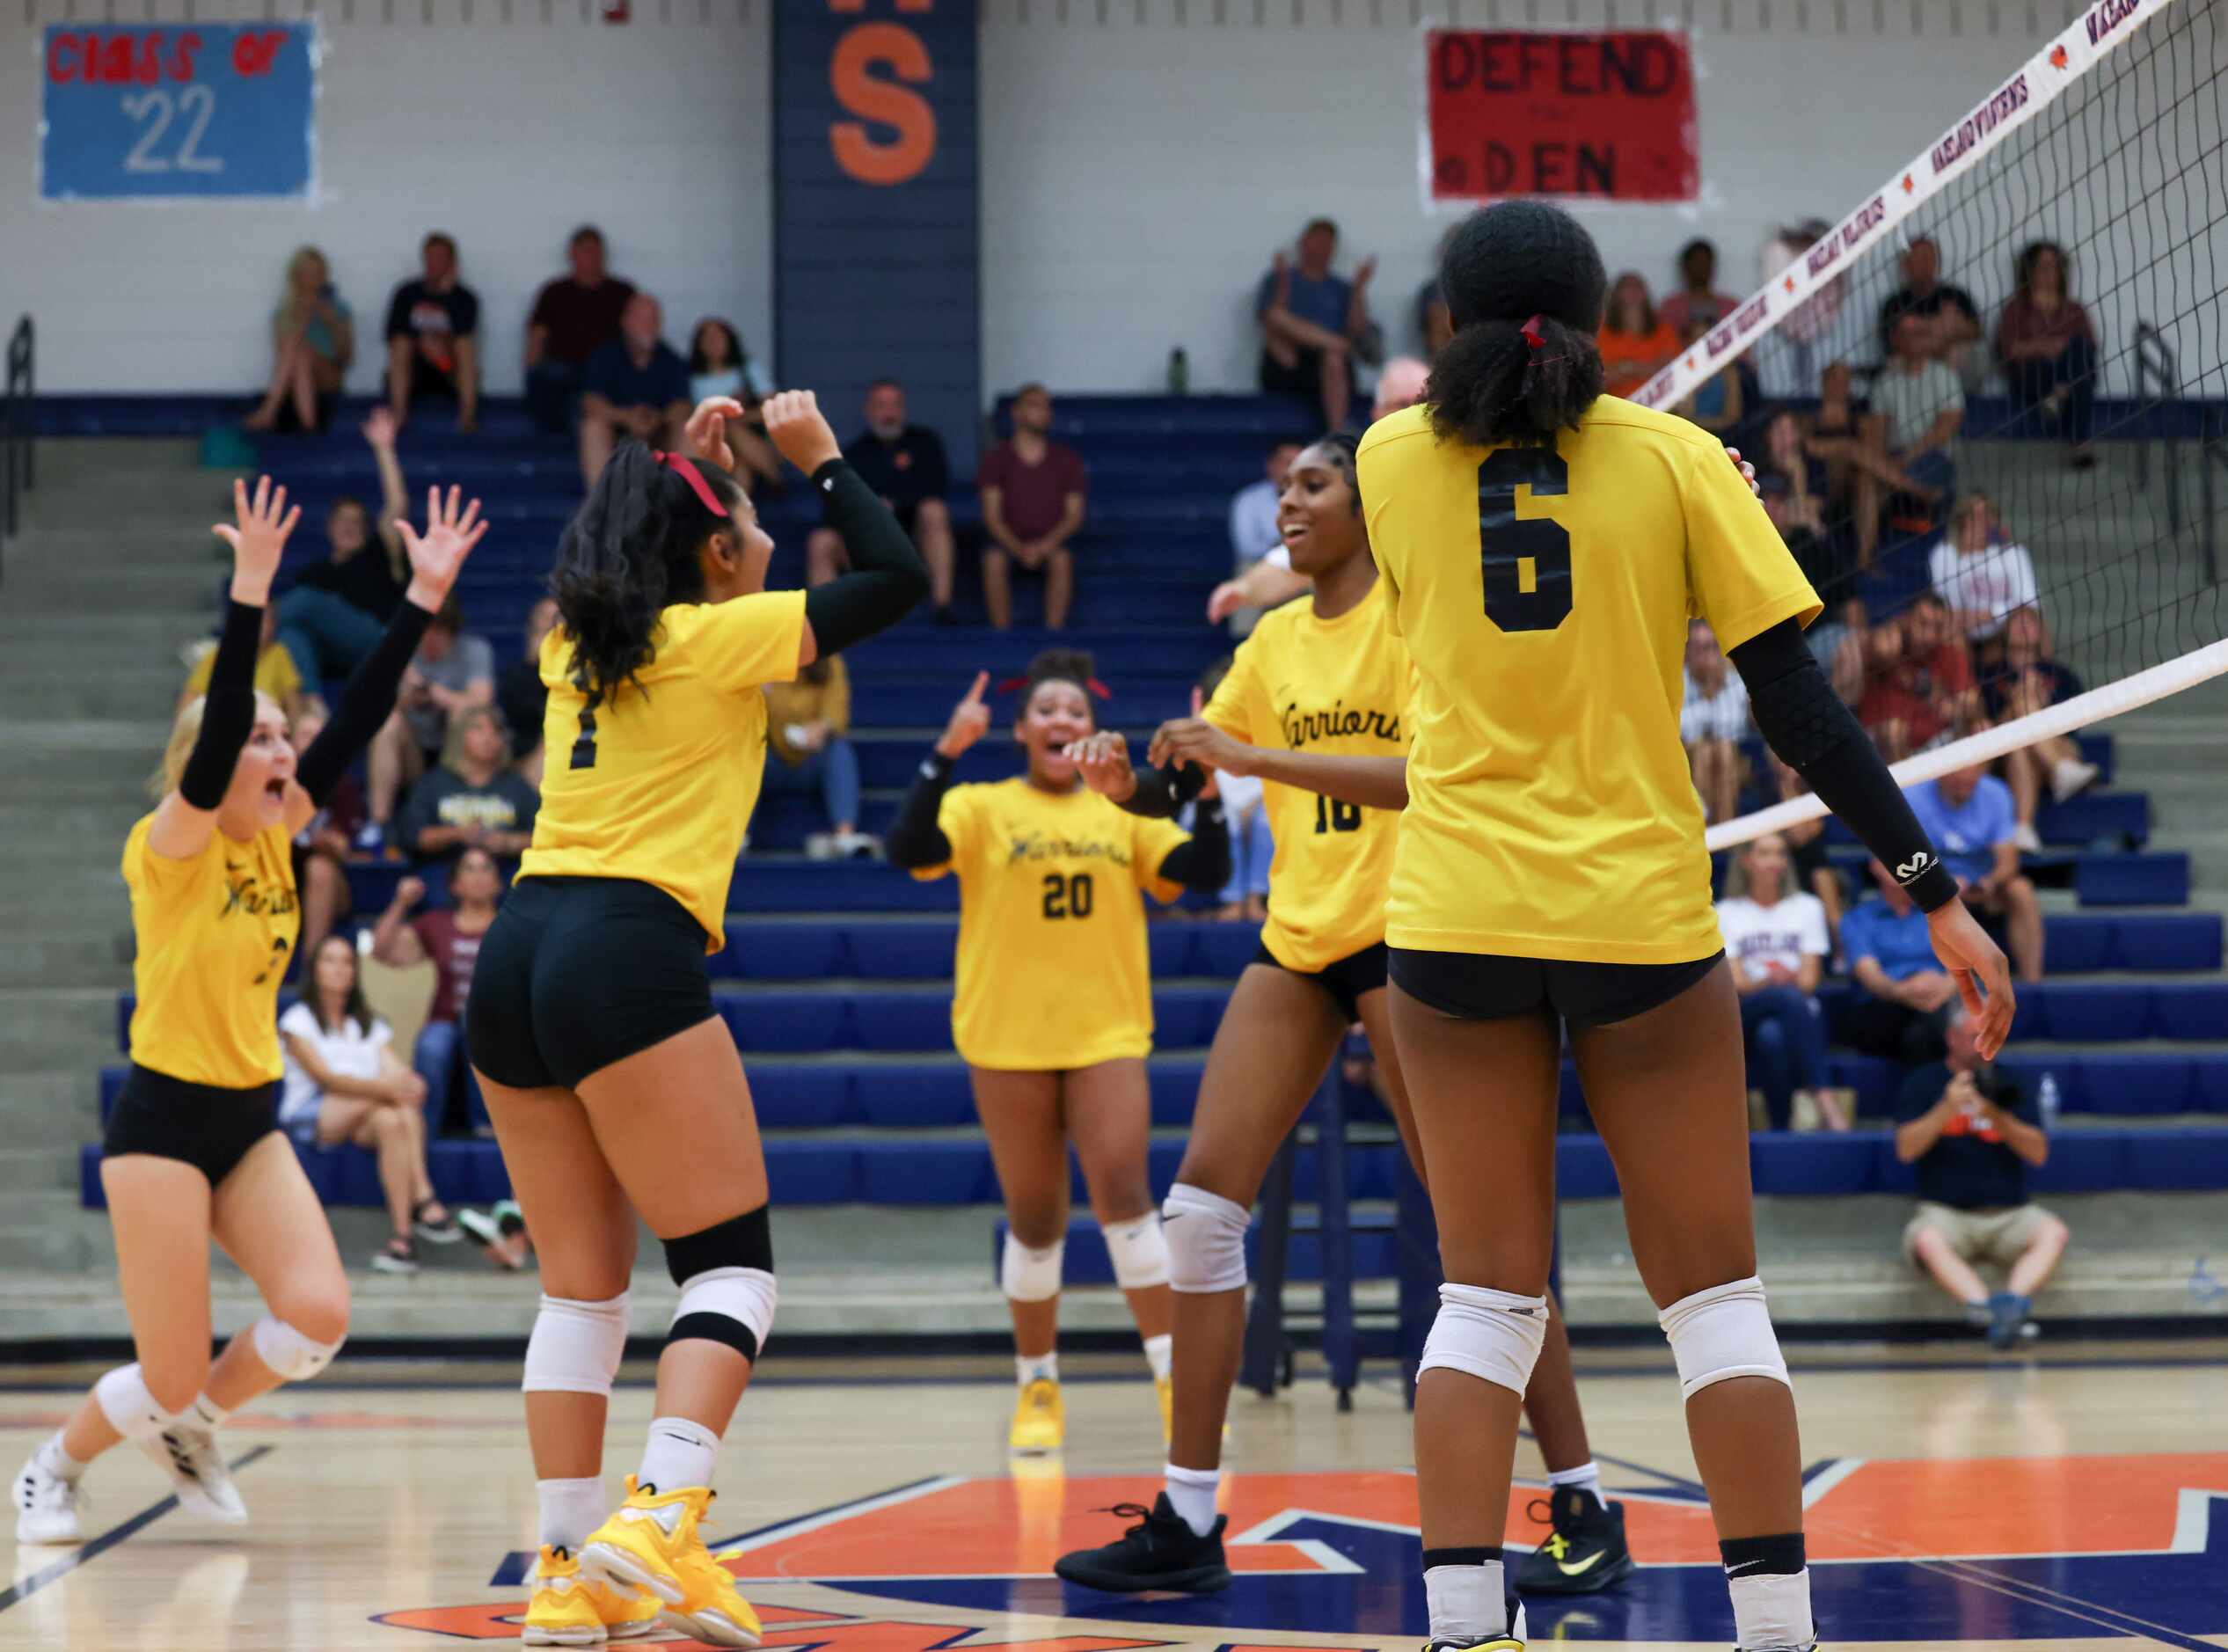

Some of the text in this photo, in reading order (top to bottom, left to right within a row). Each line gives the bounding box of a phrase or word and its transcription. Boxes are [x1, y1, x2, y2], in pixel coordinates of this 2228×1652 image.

[825, 0, 938, 187] S
[1440, 33, 1676, 96] DEFEND
[1484, 140, 1616, 196] DEN
[1478, 446, 1574, 633] 6
[1043, 872, 1093, 919] 20
